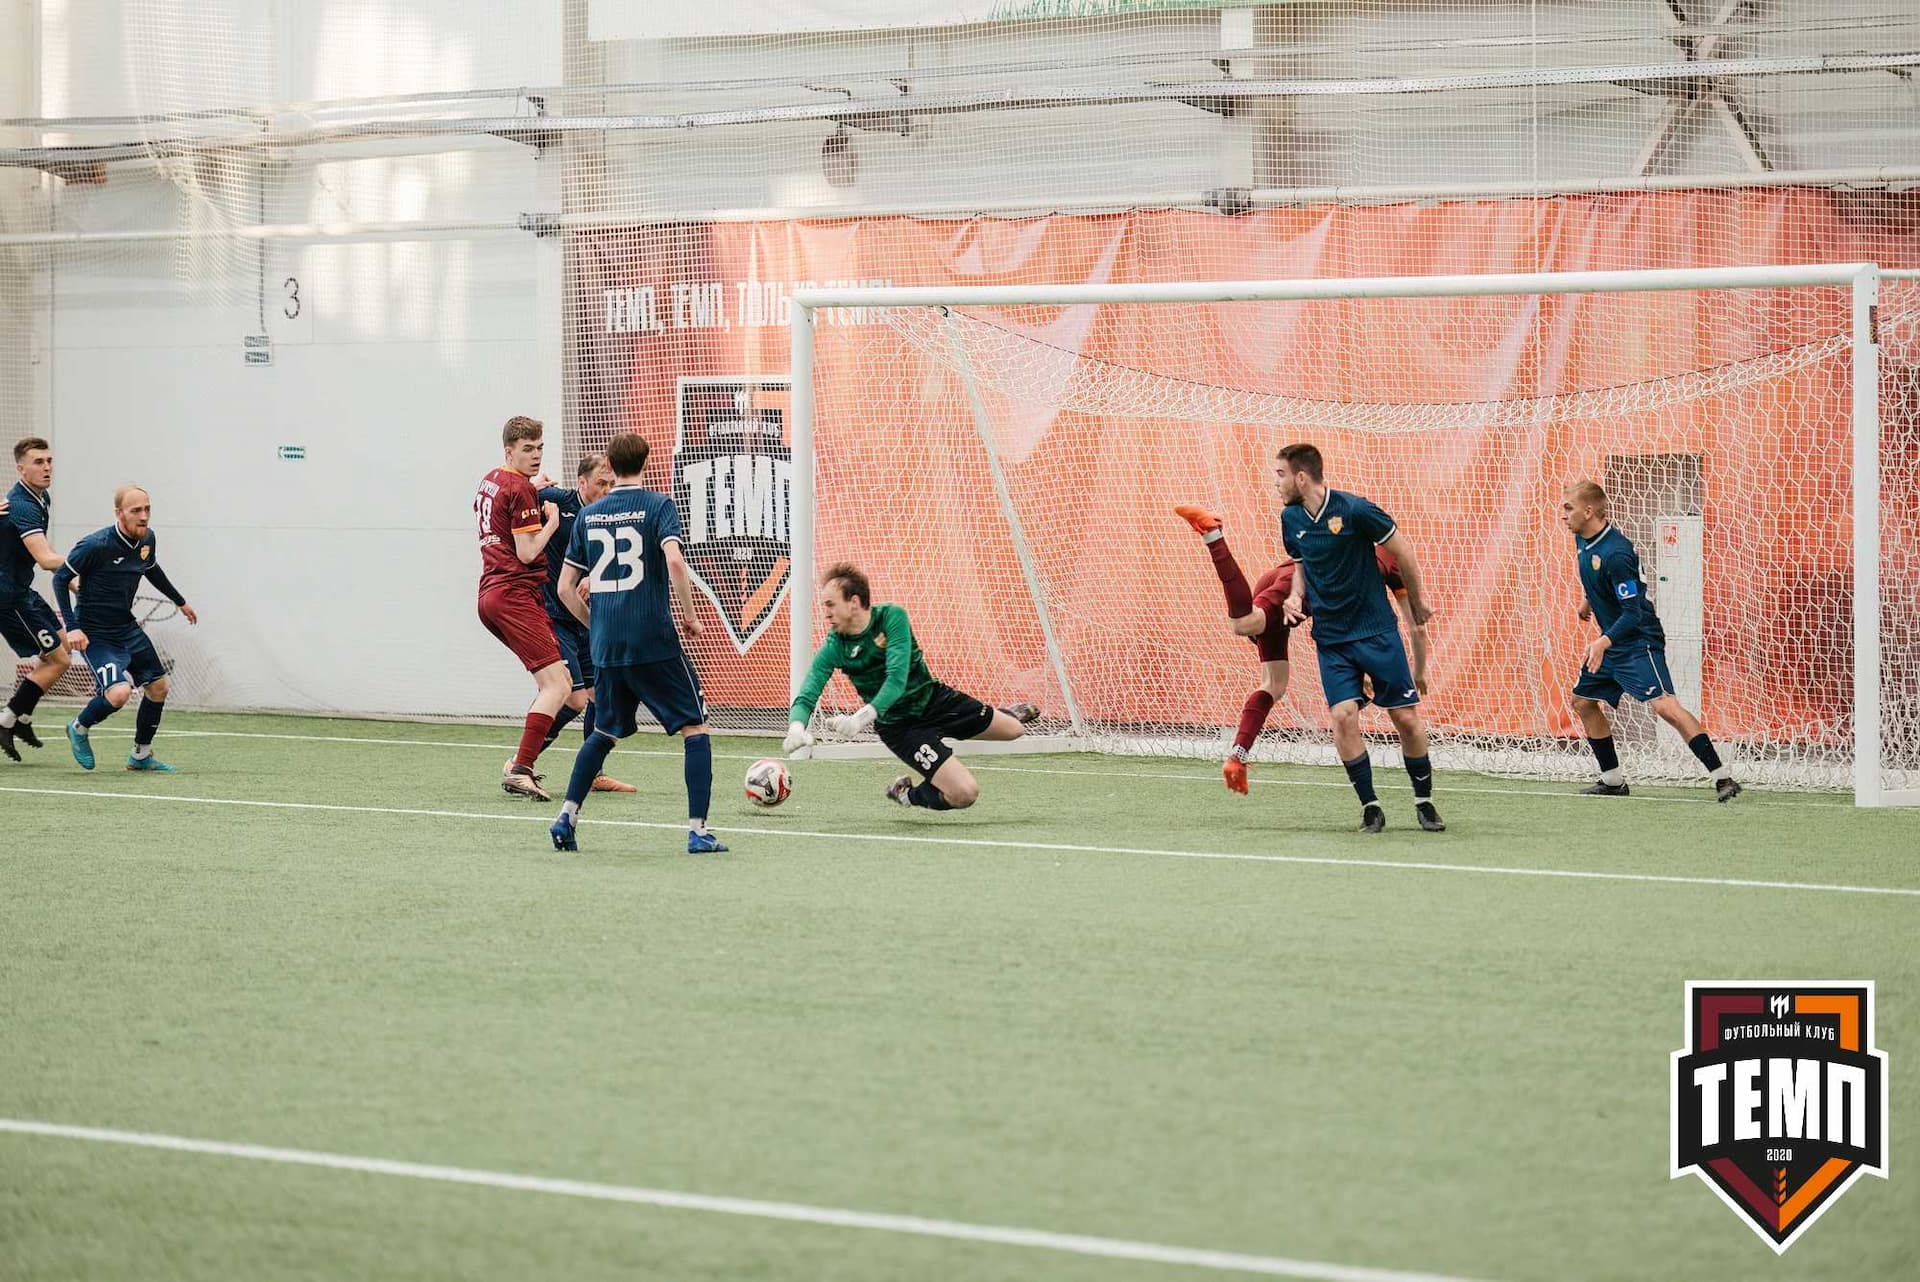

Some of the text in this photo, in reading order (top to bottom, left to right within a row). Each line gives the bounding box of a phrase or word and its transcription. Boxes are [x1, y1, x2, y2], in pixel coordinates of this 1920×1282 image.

[284, 277, 301, 320] 3
[588, 526, 644, 593] 23
[1618, 583, 1629, 597] C
[37, 629, 54, 648] 6
[914, 743, 939, 770] 33
